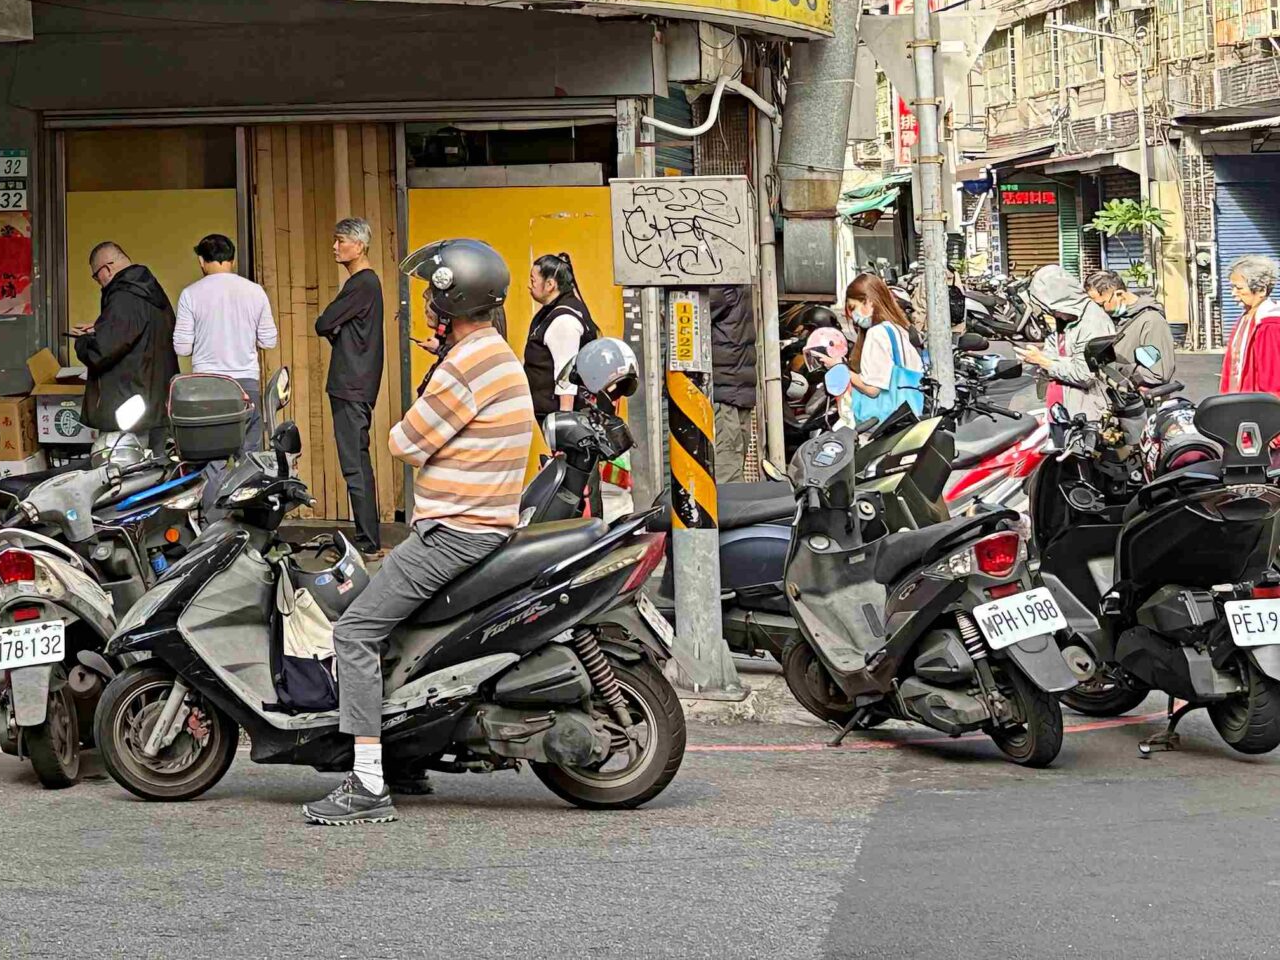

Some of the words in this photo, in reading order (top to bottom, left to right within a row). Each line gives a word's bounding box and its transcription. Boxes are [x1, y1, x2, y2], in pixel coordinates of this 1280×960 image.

[4, 159, 21, 175] 32
[0, 192, 23, 209] 32
[981, 599, 1058, 639] MPH-1988
